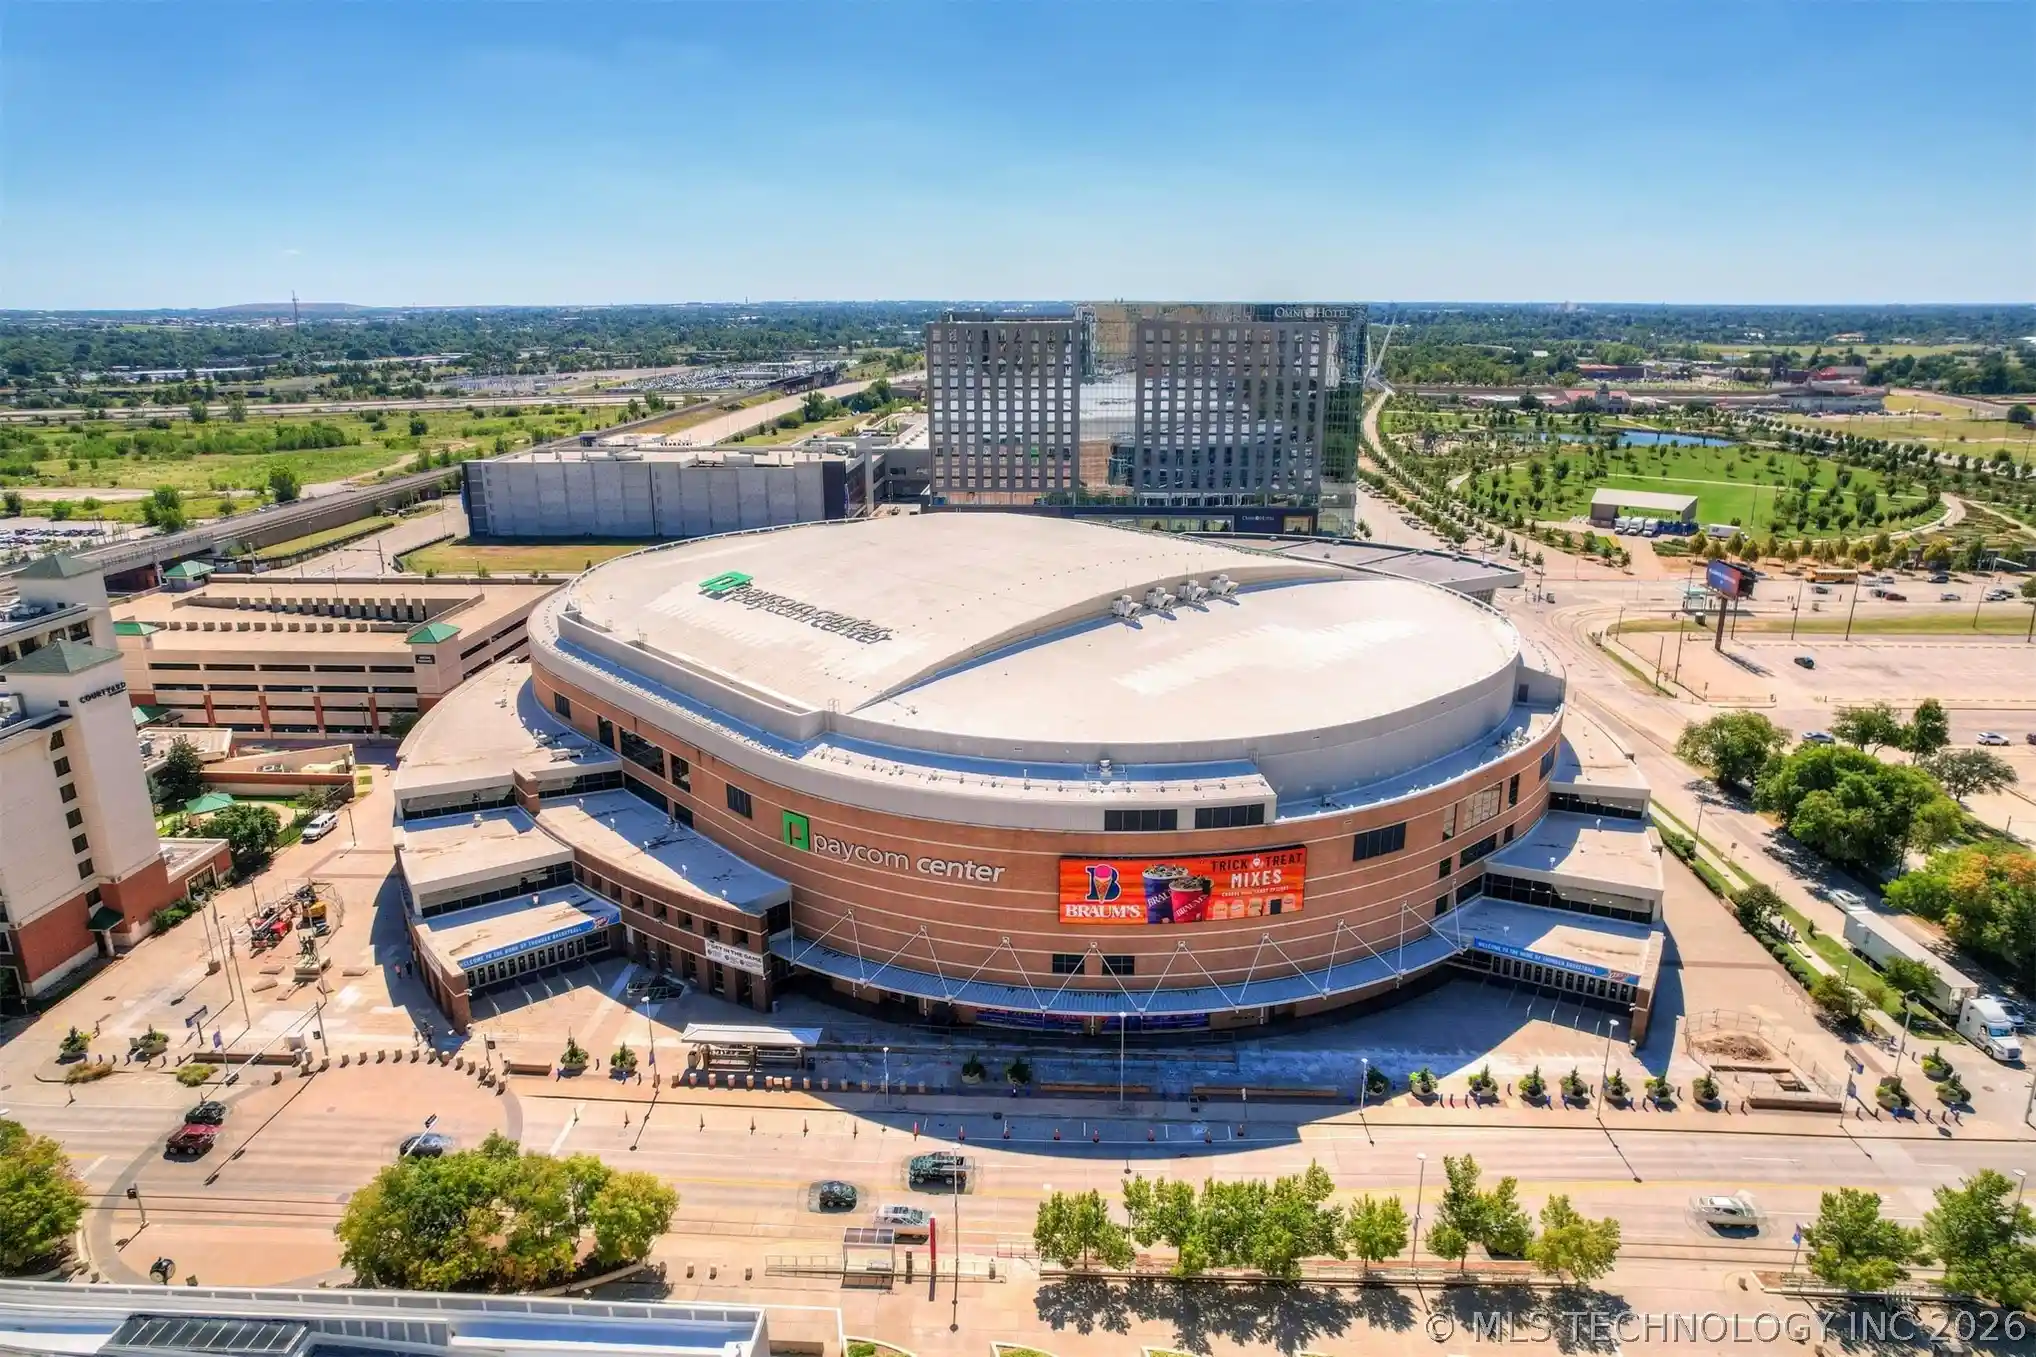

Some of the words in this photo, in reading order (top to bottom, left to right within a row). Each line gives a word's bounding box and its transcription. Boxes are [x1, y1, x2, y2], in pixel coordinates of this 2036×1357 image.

[1275, 306, 1303, 318] OMNI
[1316, 307, 1350, 318] HOTEL
[79, 681, 126, 704] COURTYARD
[814, 833, 910, 870] paycom
[917, 857, 1005, 882] center
[1211, 859, 1248, 872] TRICK
[1265, 853, 1303, 868] TREAT
[1230, 868, 1282, 889] MIXES
[1065, 904, 1141, 918] BRAUM'S
